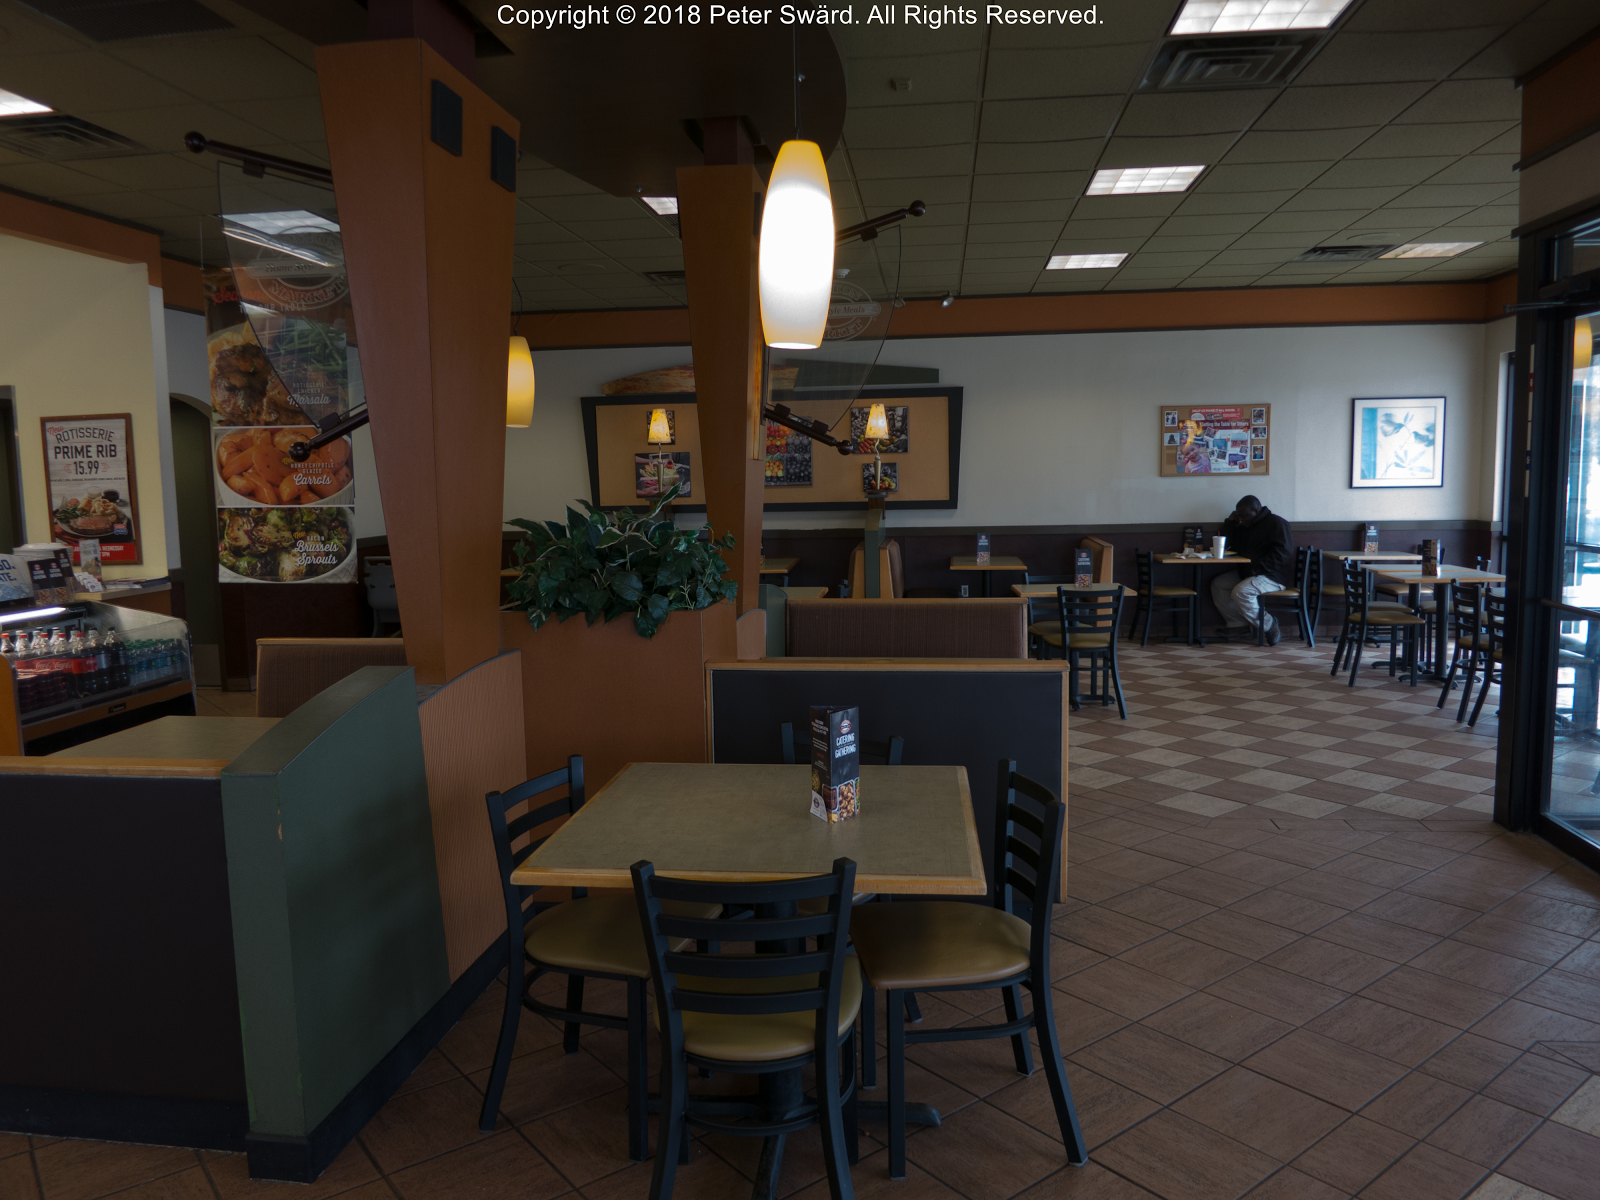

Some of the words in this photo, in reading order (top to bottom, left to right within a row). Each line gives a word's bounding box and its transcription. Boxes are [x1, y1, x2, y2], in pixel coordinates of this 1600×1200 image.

[269, 275, 345, 305] MARKET
[842, 305, 866, 314] Meals
[824, 319, 864, 339] RKET
[287, 393, 331, 407] Marsala
[55, 428, 115, 444] ROTISSERIE
[54, 445, 93, 459] PRIME
[96, 444, 118, 458] RIB
[73, 460, 100, 475] 15.99
[293, 473, 332, 486] Carrots
[294, 540, 340, 552] Brussels
[297, 552, 338, 566] Sprouts
[836, 732, 855, 746] CATERING
